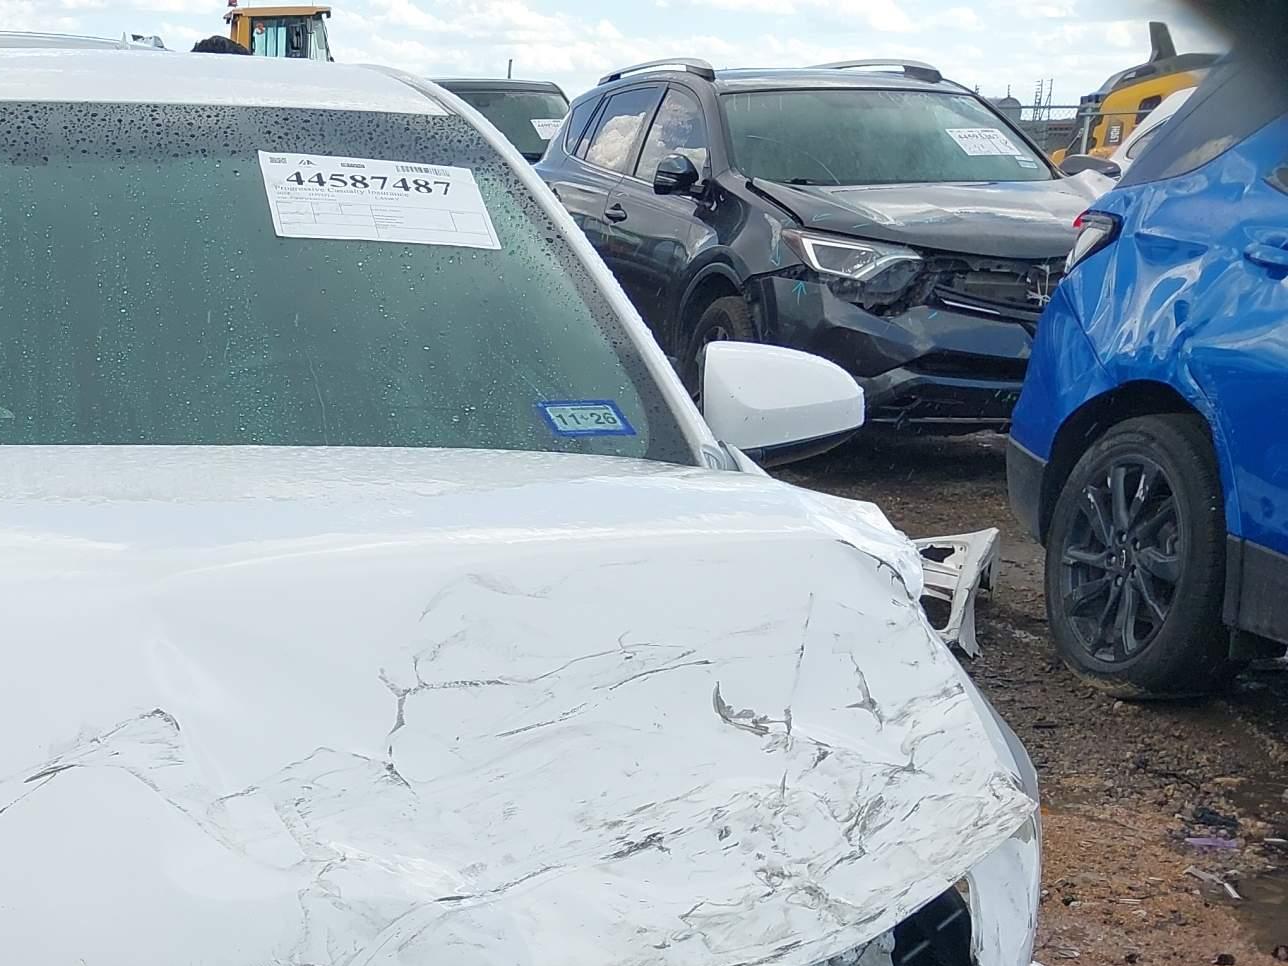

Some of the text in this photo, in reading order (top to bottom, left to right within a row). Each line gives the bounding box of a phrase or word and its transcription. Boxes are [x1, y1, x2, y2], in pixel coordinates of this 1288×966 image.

[274, 184, 410, 198] Progressive Casualty Insurance
[286, 170, 451, 196] 44587487
